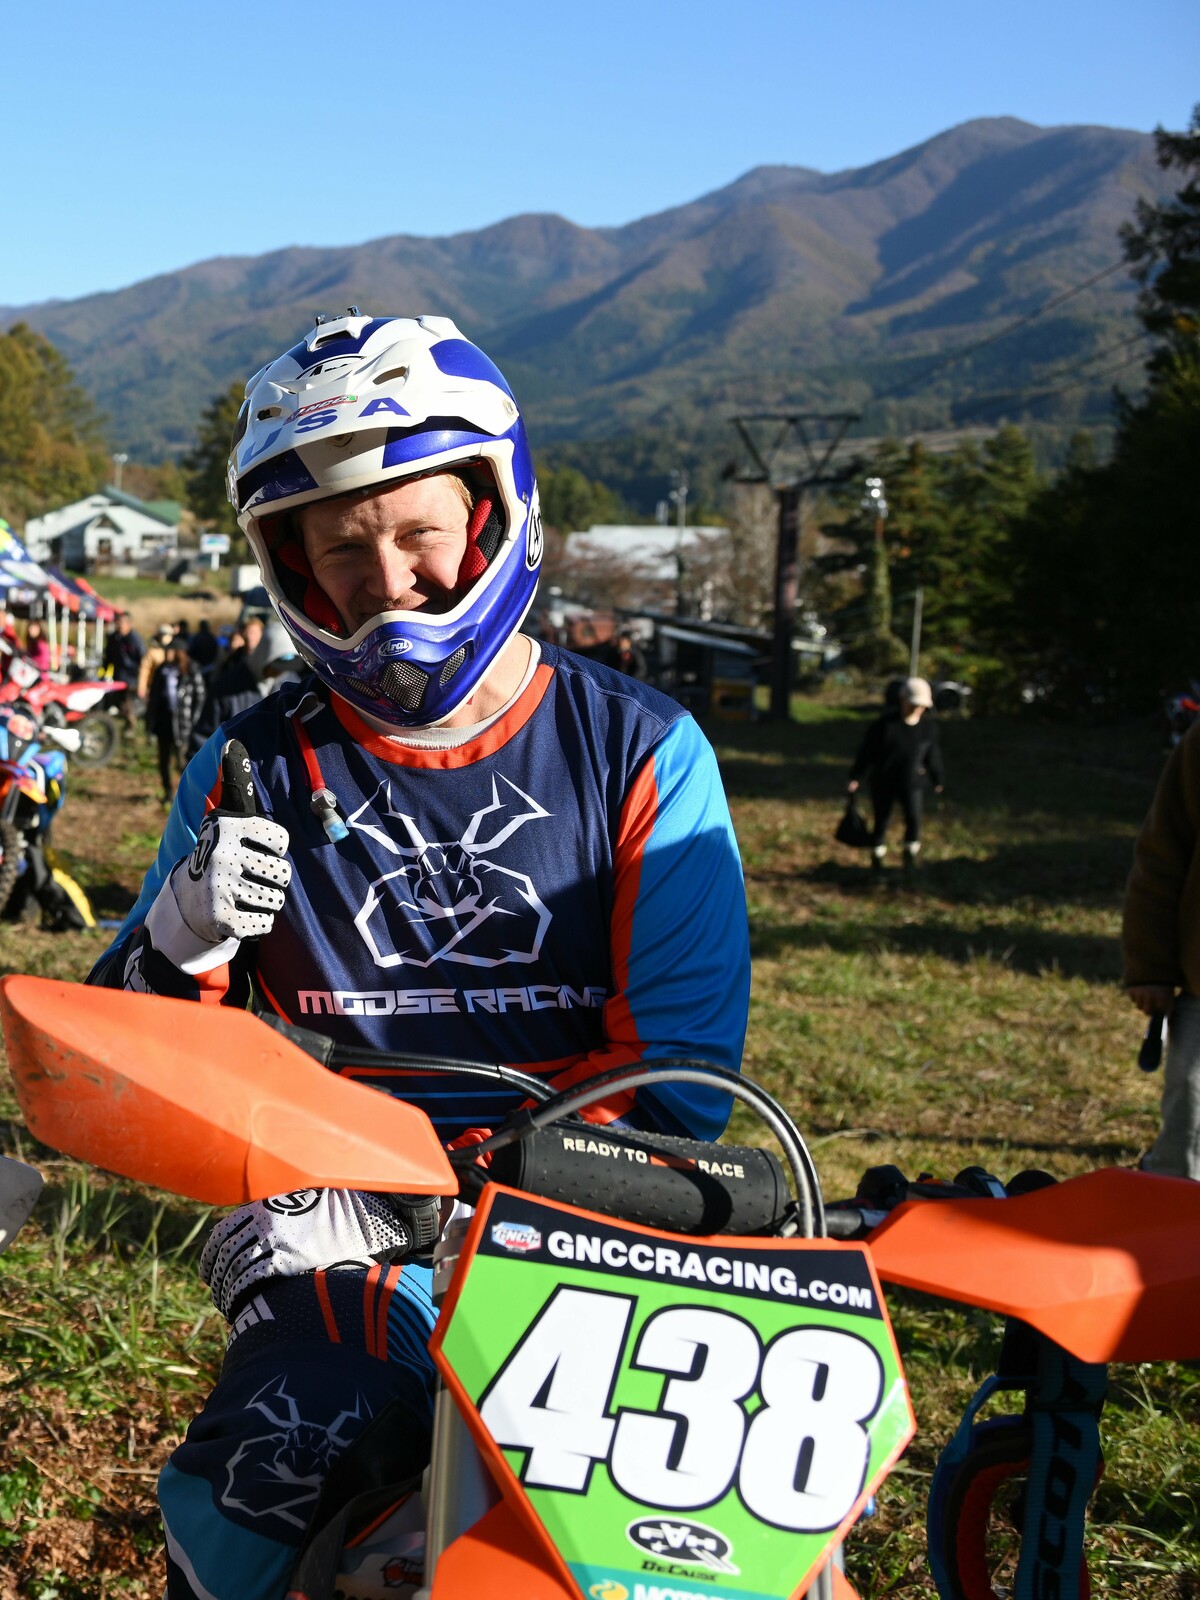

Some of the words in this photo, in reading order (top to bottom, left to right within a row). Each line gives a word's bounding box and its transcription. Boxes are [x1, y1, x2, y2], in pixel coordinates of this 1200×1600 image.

[240, 397, 411, 467] USA
[382, 640, 409, 653] Arai
[298, 988, 461, 1016] MOOSE
[562, 1137, 621, 1160] READY
[624, 1147, 648, 1164] TO
[698, 1159, 745, 1179] RACE
[547, 1230, 873, 1310] GNCCRACING.COM
[476, 1282, 886, 1535] 438
